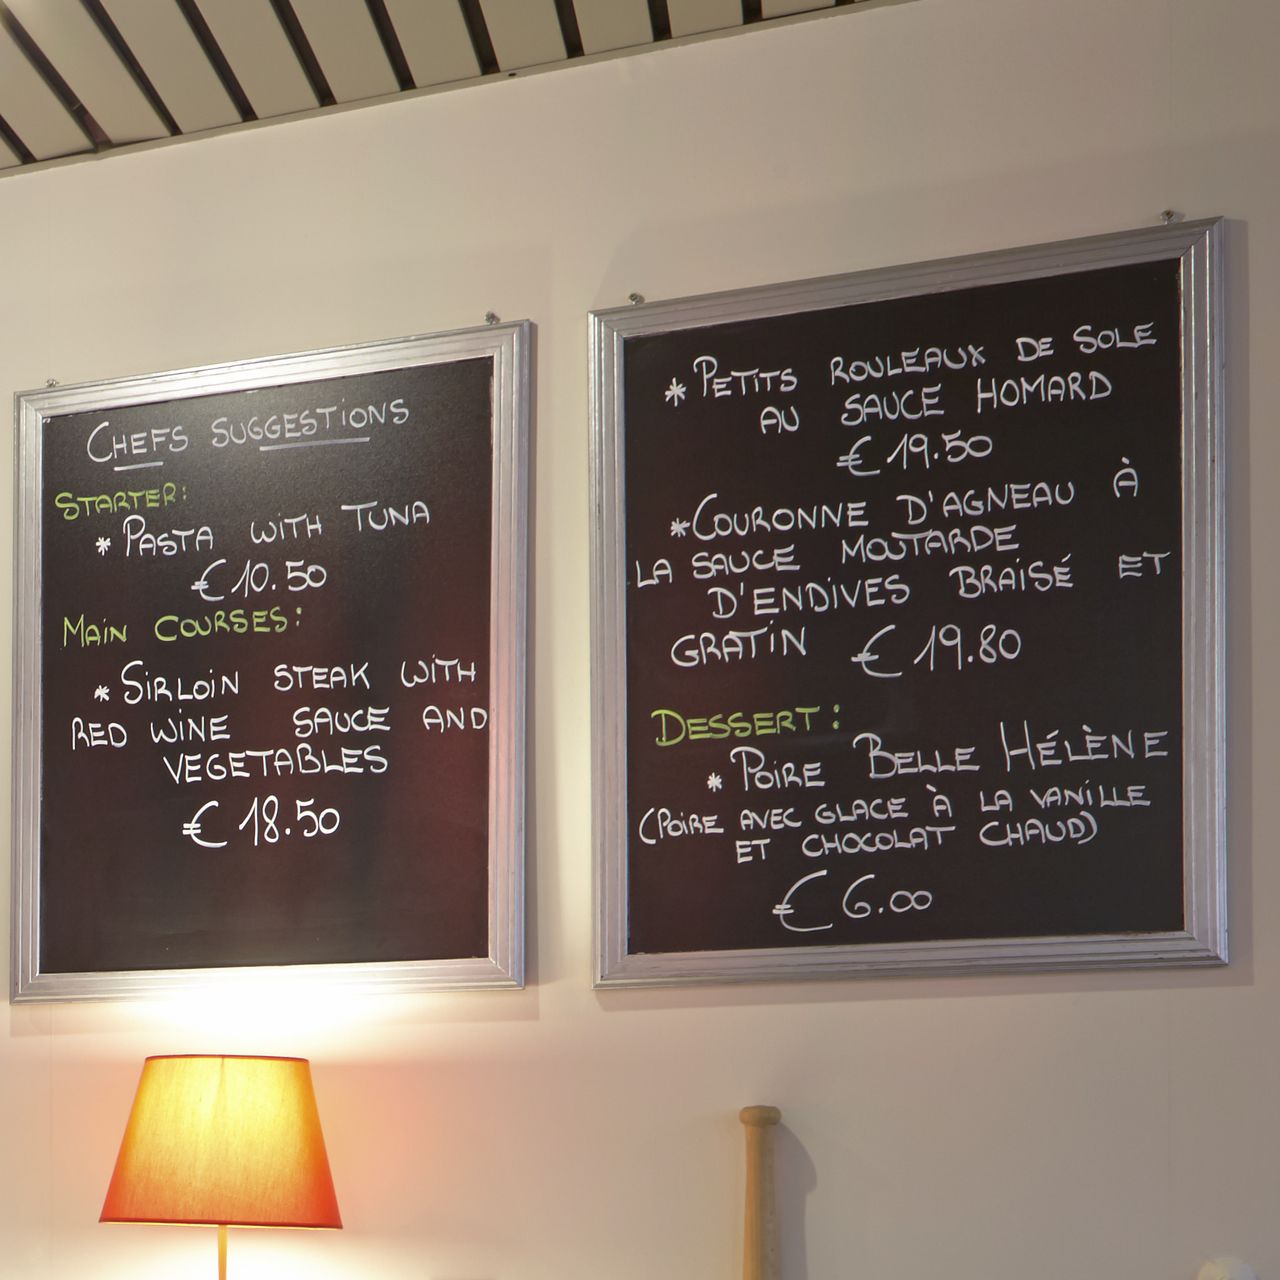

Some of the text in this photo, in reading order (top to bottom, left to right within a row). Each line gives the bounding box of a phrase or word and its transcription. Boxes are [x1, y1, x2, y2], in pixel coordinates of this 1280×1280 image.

[693, 356, 797, 398] PETITS
[830, 345, 985, 389] ROULEAUX
[1016, 337, 1054, 361] DE
[760, 371, 1112, 434] AU SAUCE HOMARD
[87, 400, 408, 462] CHEFS SUGGESTIONS
[55, 483, 186, 523] STARTER:
[896, 482, 1074, 525] D'AGNEAU
[1113, 457, 1138, 498] À
[123, 501, 429, 556] PASTA WITH TUNA
[636, 525, 1020, 588] LA SAUCE MOUTARDE
[707, 552, 1170, 618] D'ENDIVES BRAISÉ ET
[64, 607, 301, 647] MAIN COURSES:
[671, 620, 806, 667] GRATIN
[121, 654, 476, 704] SIRLOIN STEAK WITH
[72, 706, 487, 750] RED WINE SAUCE AND
[163, 743, 388, 784] VEGETABLES
[730, 746, 825, 791] POIRE
[853, 733, 980, 778] BELLE
[740, 808, 802, 830] AVEC
[815, 798, 908, 824] GLACE
[927, 784, 952, 817] À
[980, 790, 1012, 812] LA
[1030, 780, 1150, 808] VANILLE
[736, 811, 1097, 863] ET CHOCOLAT CHAUD)
